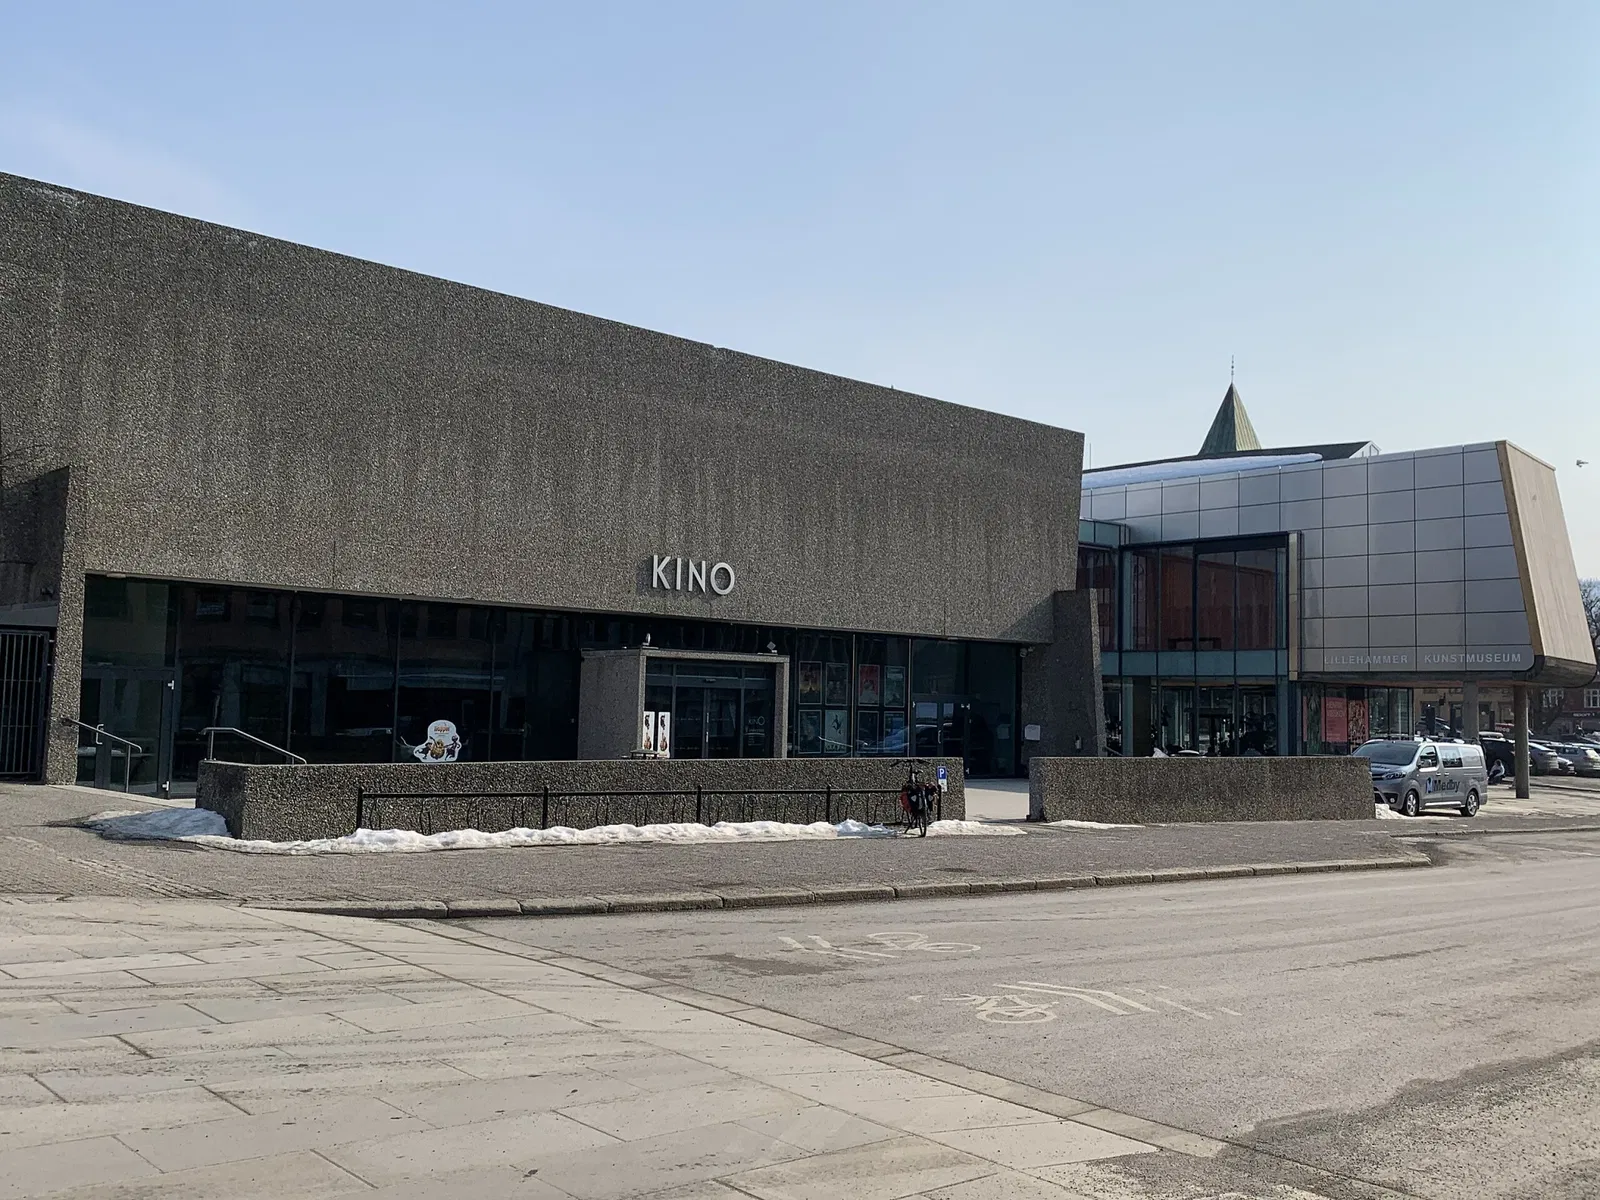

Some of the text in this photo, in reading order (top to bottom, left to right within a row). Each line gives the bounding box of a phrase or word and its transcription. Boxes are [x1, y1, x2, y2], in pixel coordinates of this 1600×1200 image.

[652, 554, 735, 595] KINO
[1324, 654, 1408, 665] LILLEHAMMER
[939, 768, 945, 778] P
